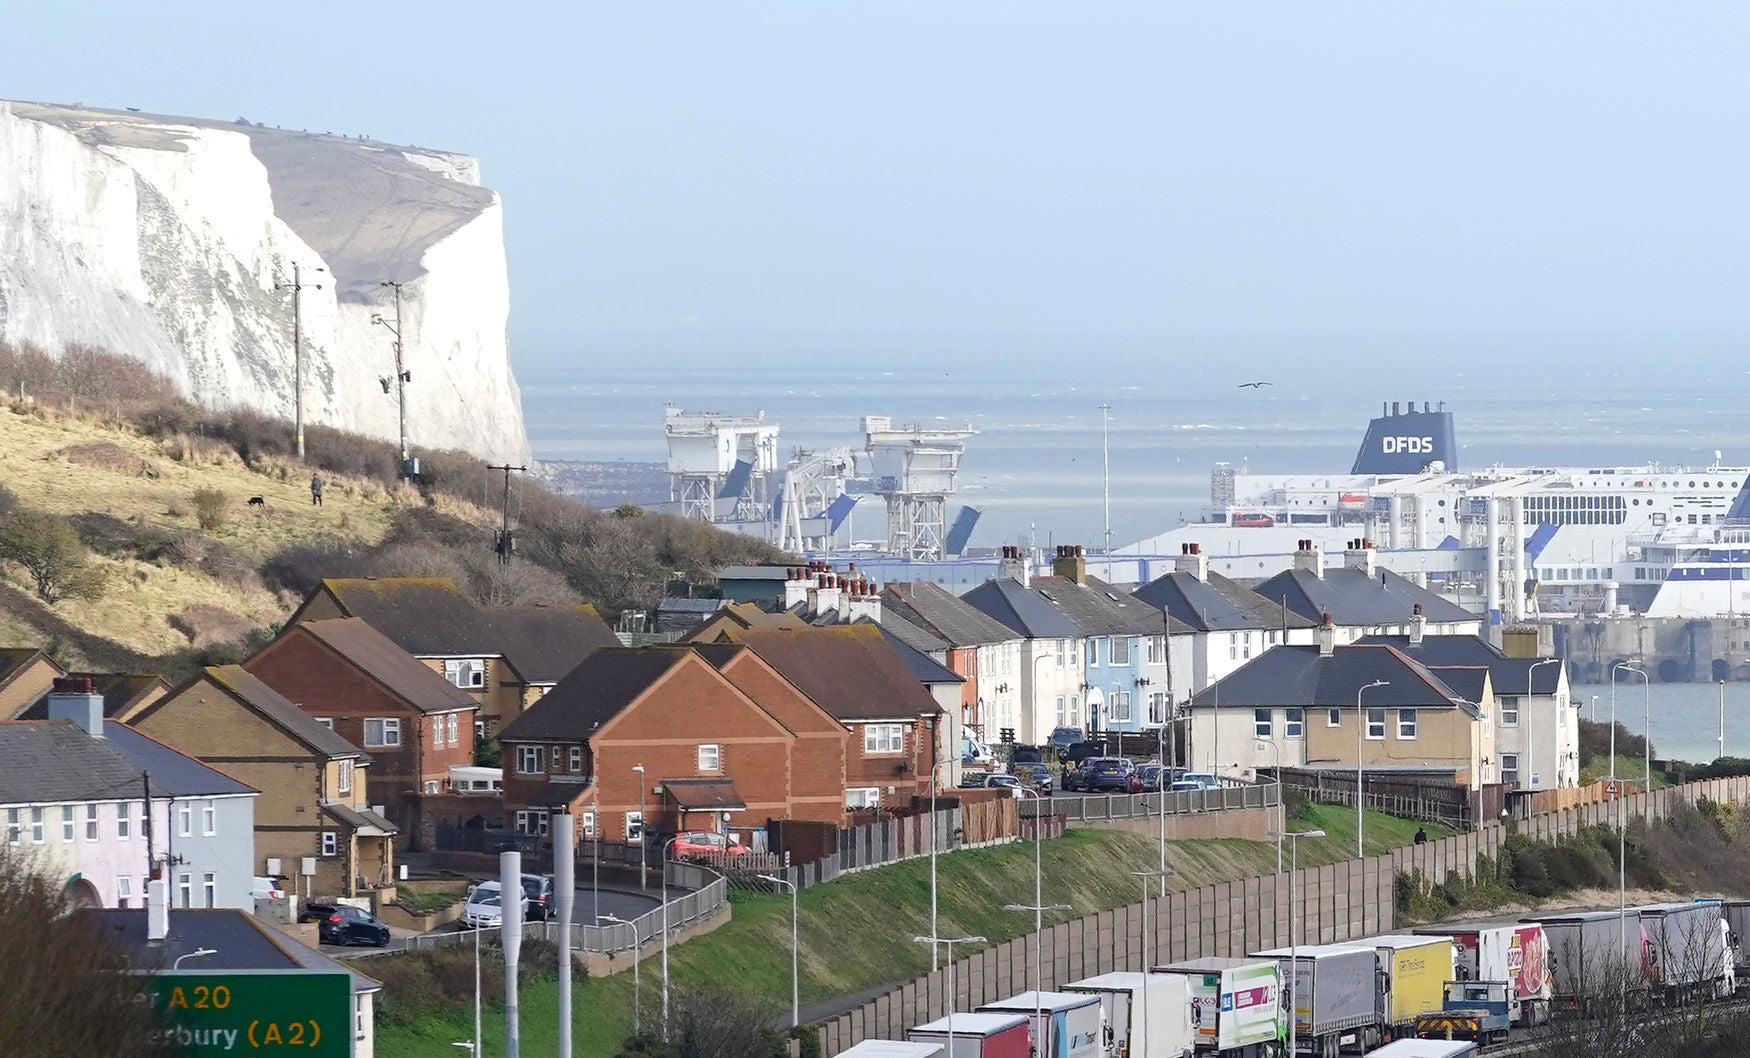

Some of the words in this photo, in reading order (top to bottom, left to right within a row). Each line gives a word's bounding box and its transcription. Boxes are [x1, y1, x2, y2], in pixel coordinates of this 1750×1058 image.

[1383, 436, 1433, 454] DFDS
[169, 985, 231, 1009] A20
[147, 1024, 239, 1050] erbury
[247, 1019, 321, 1048] (A2)
